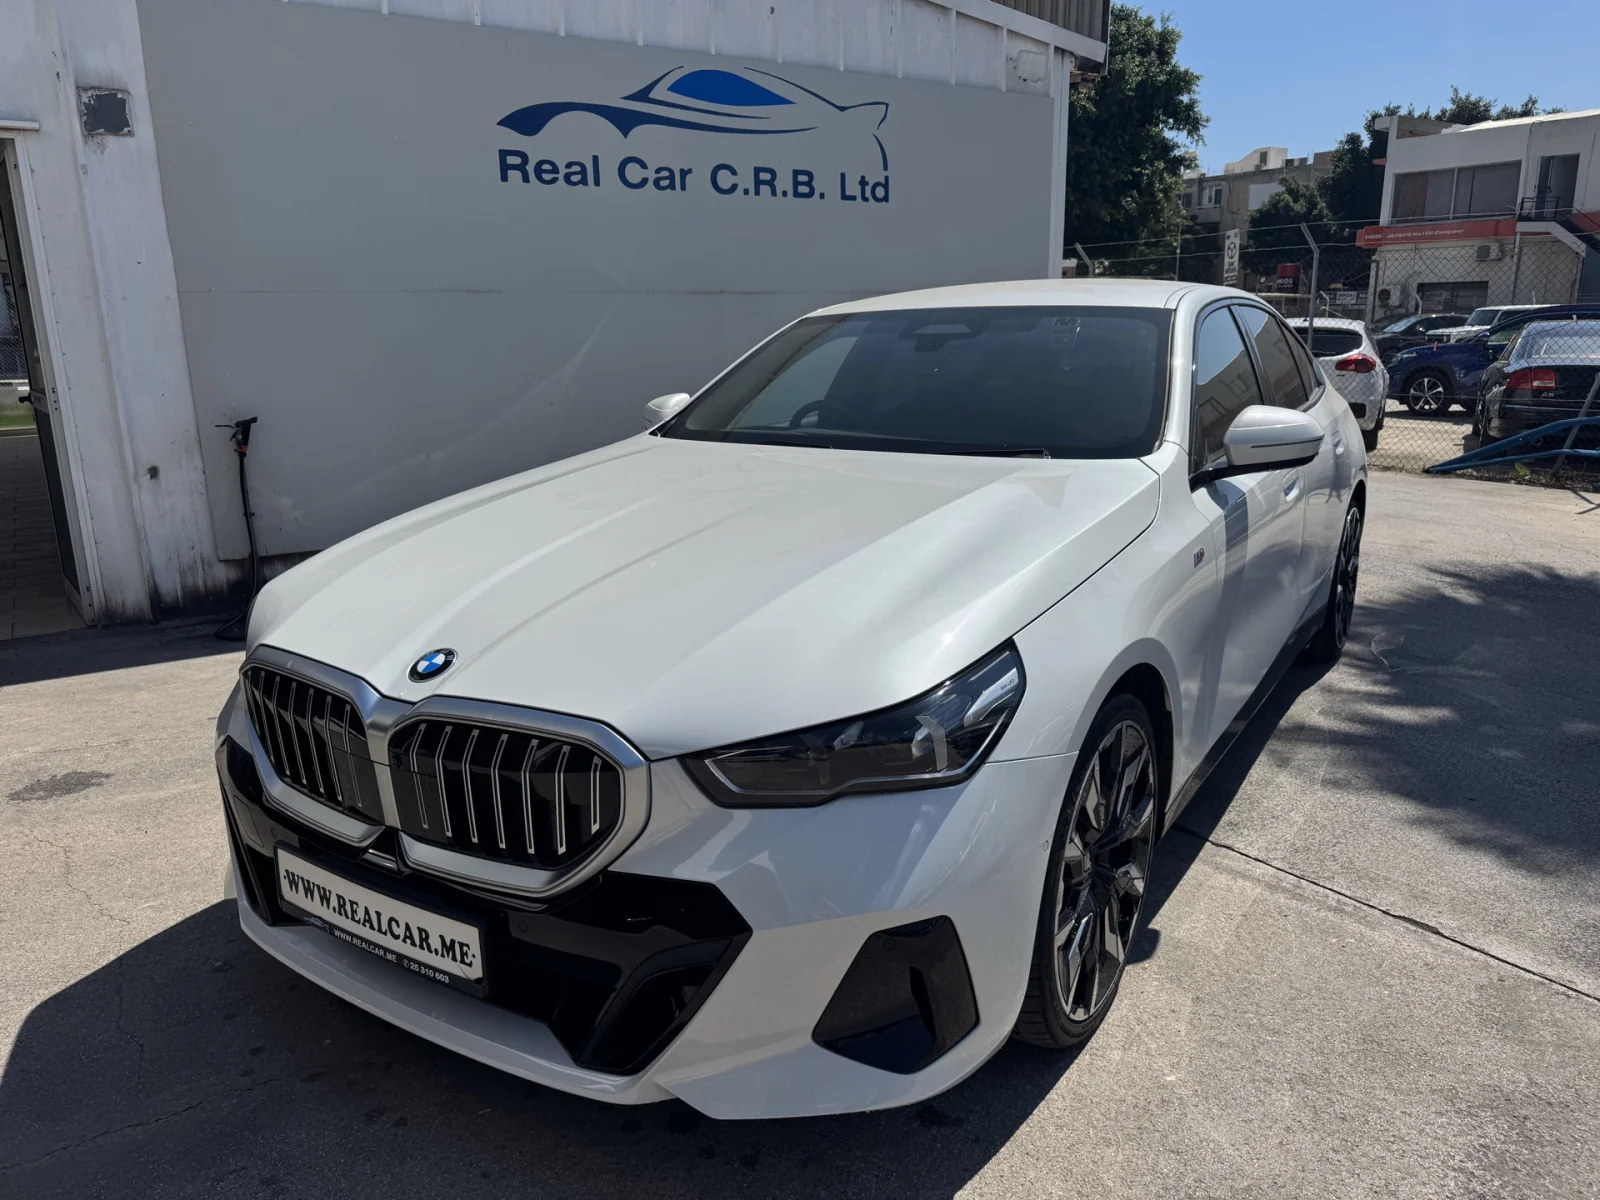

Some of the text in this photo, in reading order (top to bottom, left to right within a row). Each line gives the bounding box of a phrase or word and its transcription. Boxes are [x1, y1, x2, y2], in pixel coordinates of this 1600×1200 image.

[498, 149, 890, 203] Real Car C.R.B. Ltd
[334, 928, 449, 983] WWW.REALCAR.ME 25 310 603
